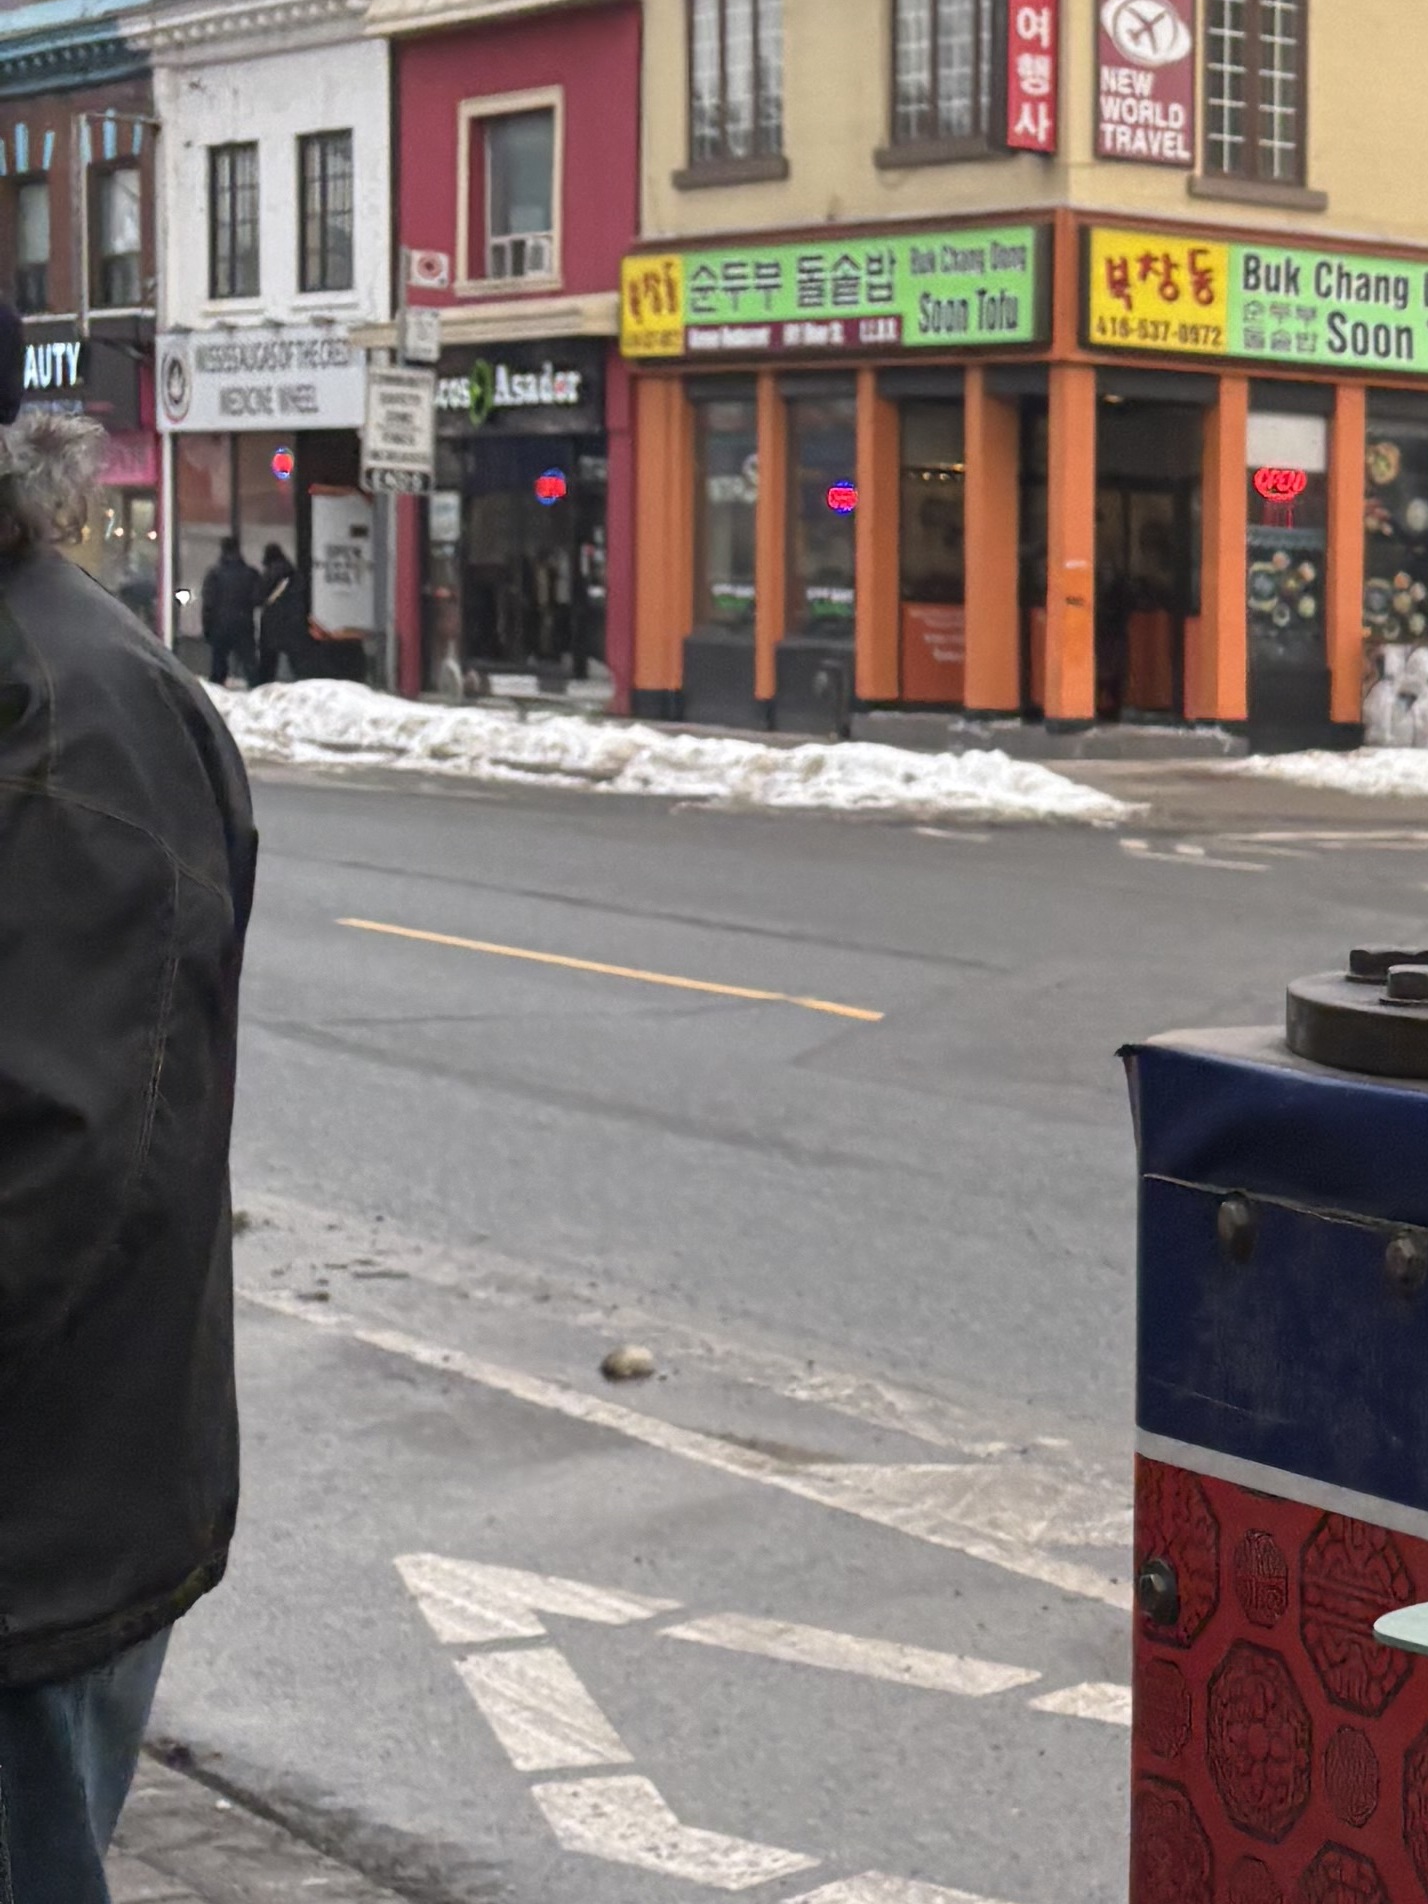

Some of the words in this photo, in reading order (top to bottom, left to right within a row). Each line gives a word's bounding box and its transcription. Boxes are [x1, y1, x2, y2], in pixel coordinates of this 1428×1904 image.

[1014, 6, 1051, 144] 여행사
[1100, 64, 1155, 97] NEW
[1100, 97, 1185, 129] WORLD
[1100, 123, 1192, 161] TRAVEL
[690, 262, 783, 313] 순두부
[797, 248, 897, 308] 돌솥밥
[1105, 248, 1214, 312] 북창동
[1243, 252, 1300, 295] Buk
[1314, 260, 1410, 311] Chang
[918, 291, 969, 333] Soon
[976, 287, 1019, 331] Tofu
[1326, 309, 1414, 360] Soon
[24, 342, 81, 390] AUTY
[436, 377, 471, 409] cos
